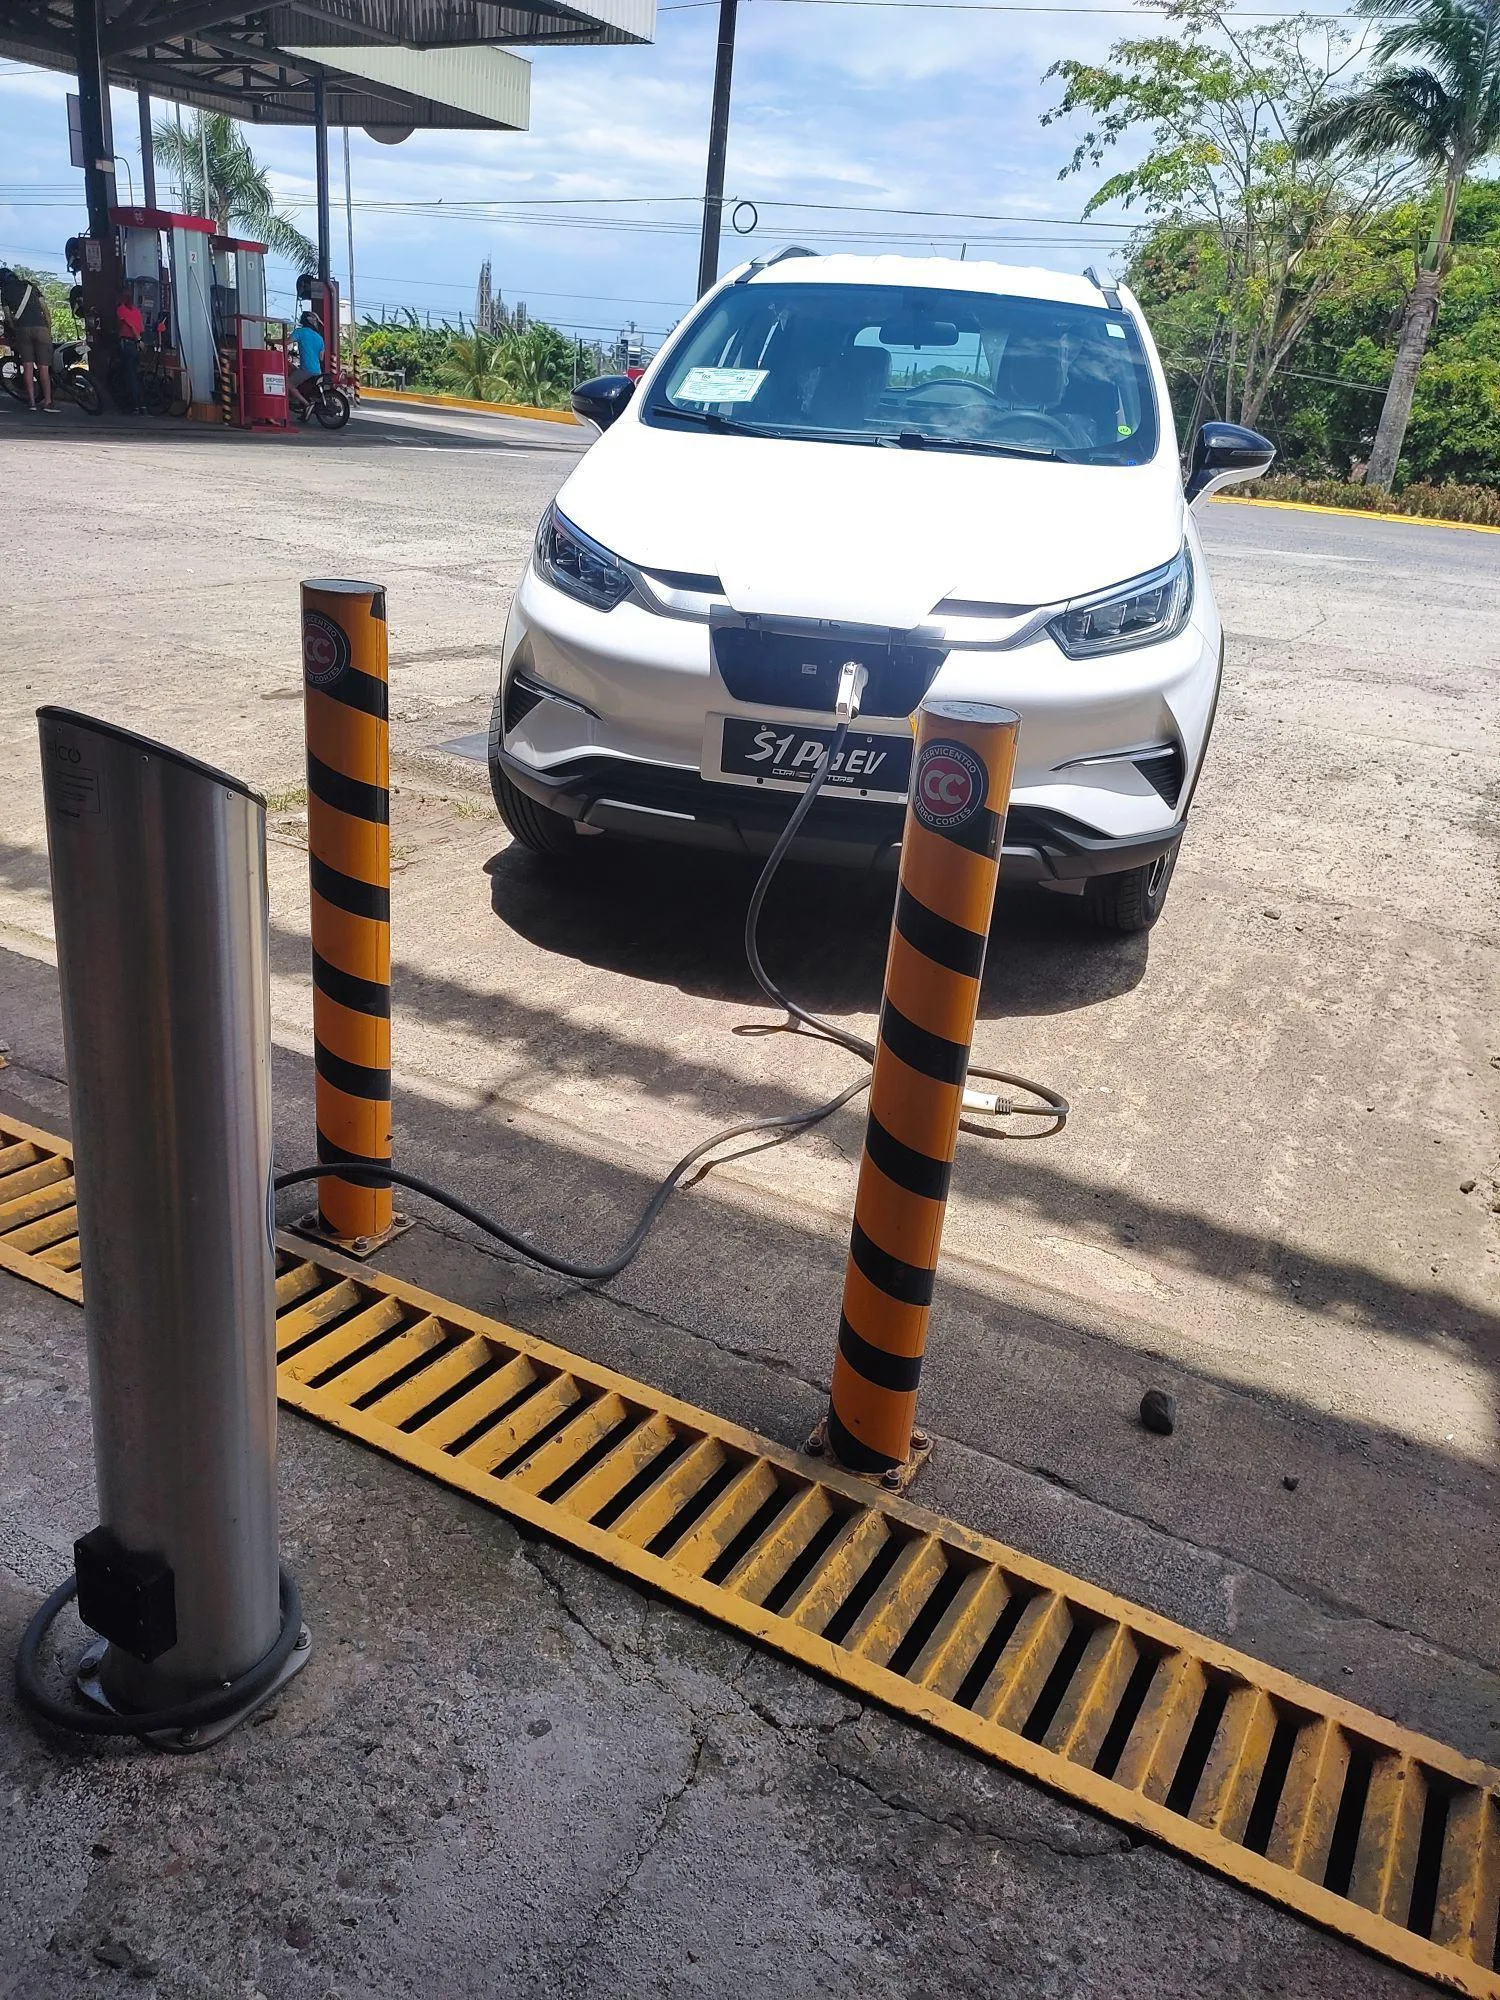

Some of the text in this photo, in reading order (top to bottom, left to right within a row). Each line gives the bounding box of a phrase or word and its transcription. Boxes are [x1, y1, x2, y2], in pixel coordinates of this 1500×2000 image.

[745, 731, 795, 764] S1
[845, 749, 887, 775] EV
[922, 747, 977, 774] SERVICENTRO
[924, 769, 966, 805] CC
[915, 795, 971, 825] CERRO CORTES
